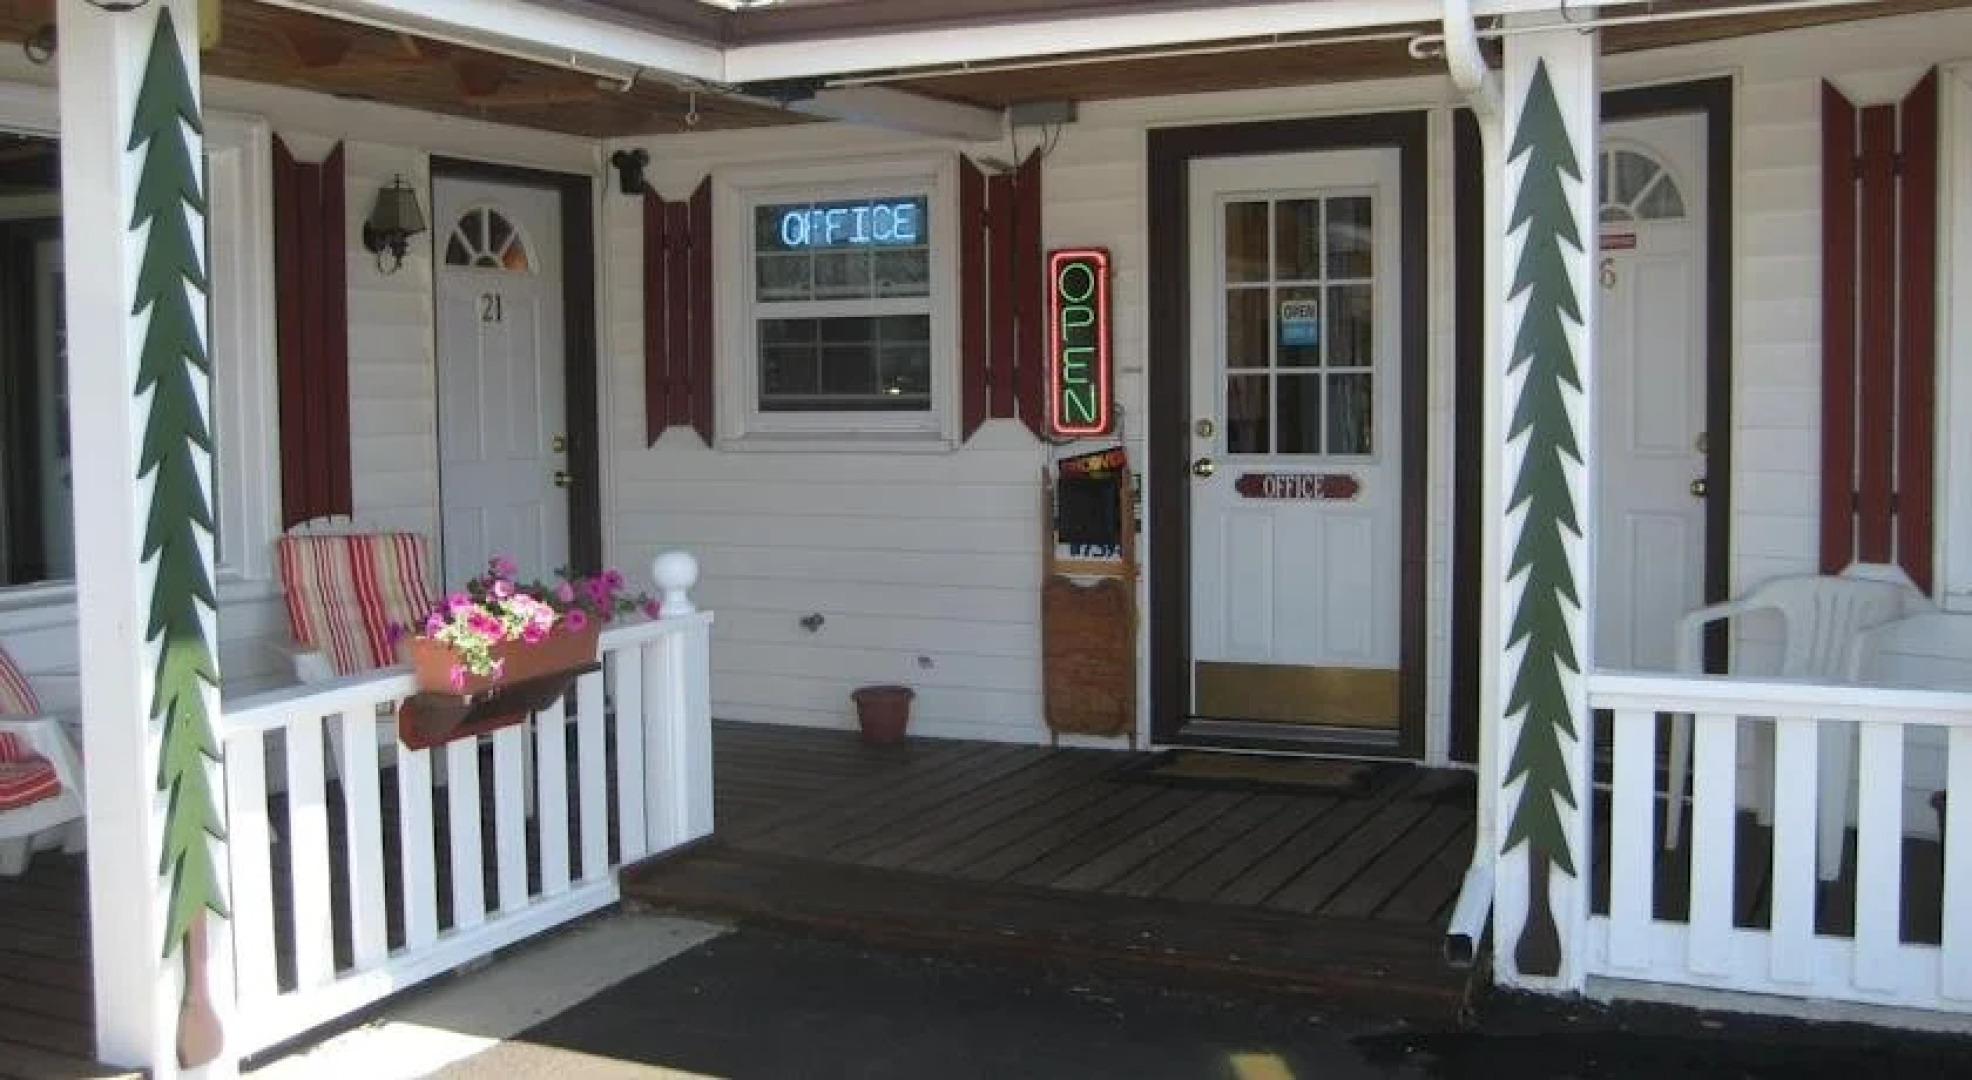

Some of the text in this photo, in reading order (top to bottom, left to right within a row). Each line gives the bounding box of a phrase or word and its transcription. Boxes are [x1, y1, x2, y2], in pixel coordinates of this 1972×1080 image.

[781, 204, 917, 245] OFFICE
[481, 293, 502, 322] 21
[1058, 262, 1096, 423] OPEN
[1262, 474, 1326, 499] OFFICE
